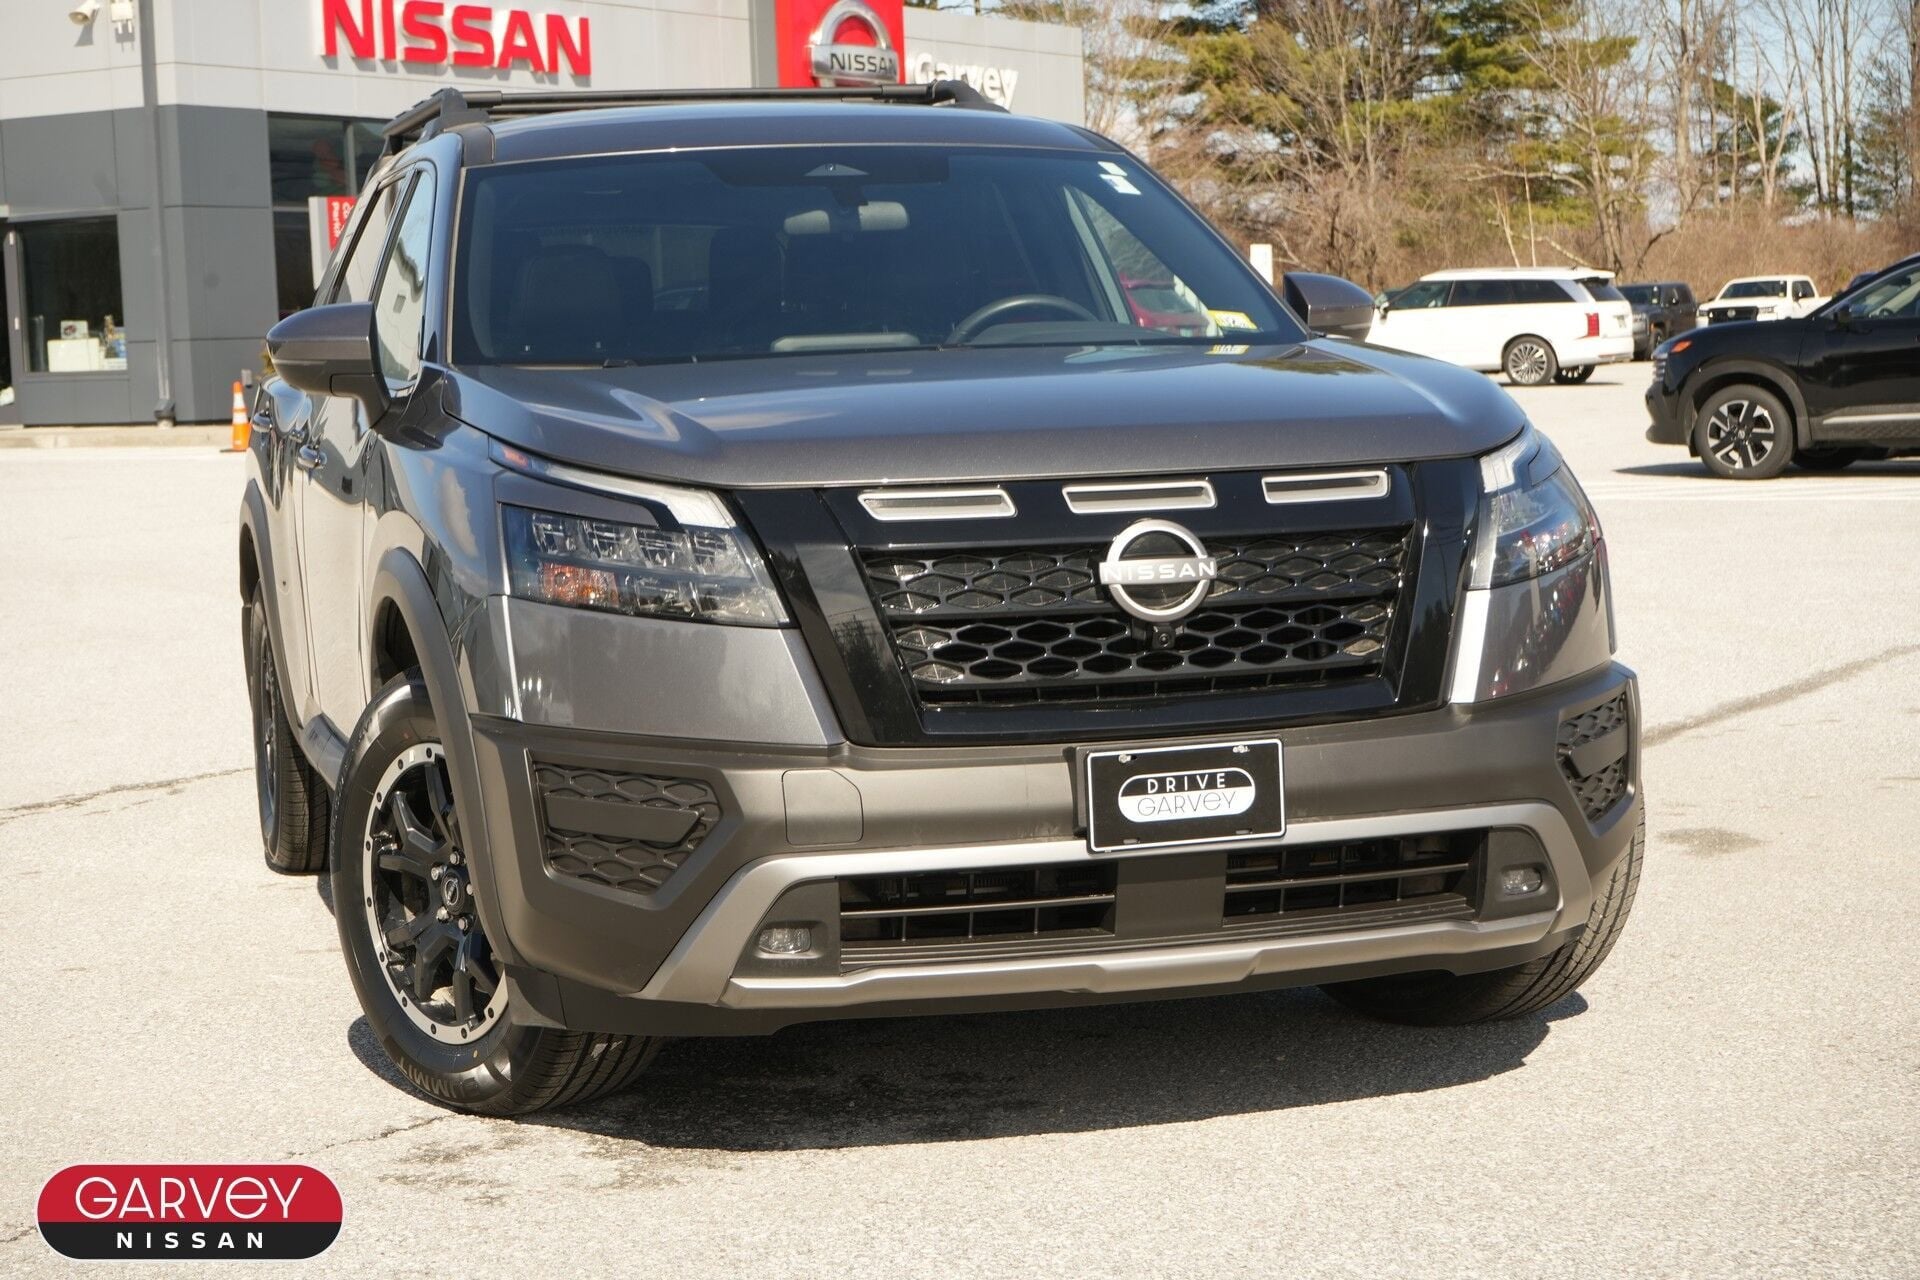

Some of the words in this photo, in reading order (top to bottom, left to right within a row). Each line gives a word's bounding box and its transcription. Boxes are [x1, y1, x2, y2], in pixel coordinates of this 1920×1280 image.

[322, 0, 591, 76] NISSAN
[829, 52, 898, 79] NISSAN
[1103, 561, 1215, 582] NISSAN
[1147, 773, 1226, 794] DRIVE
